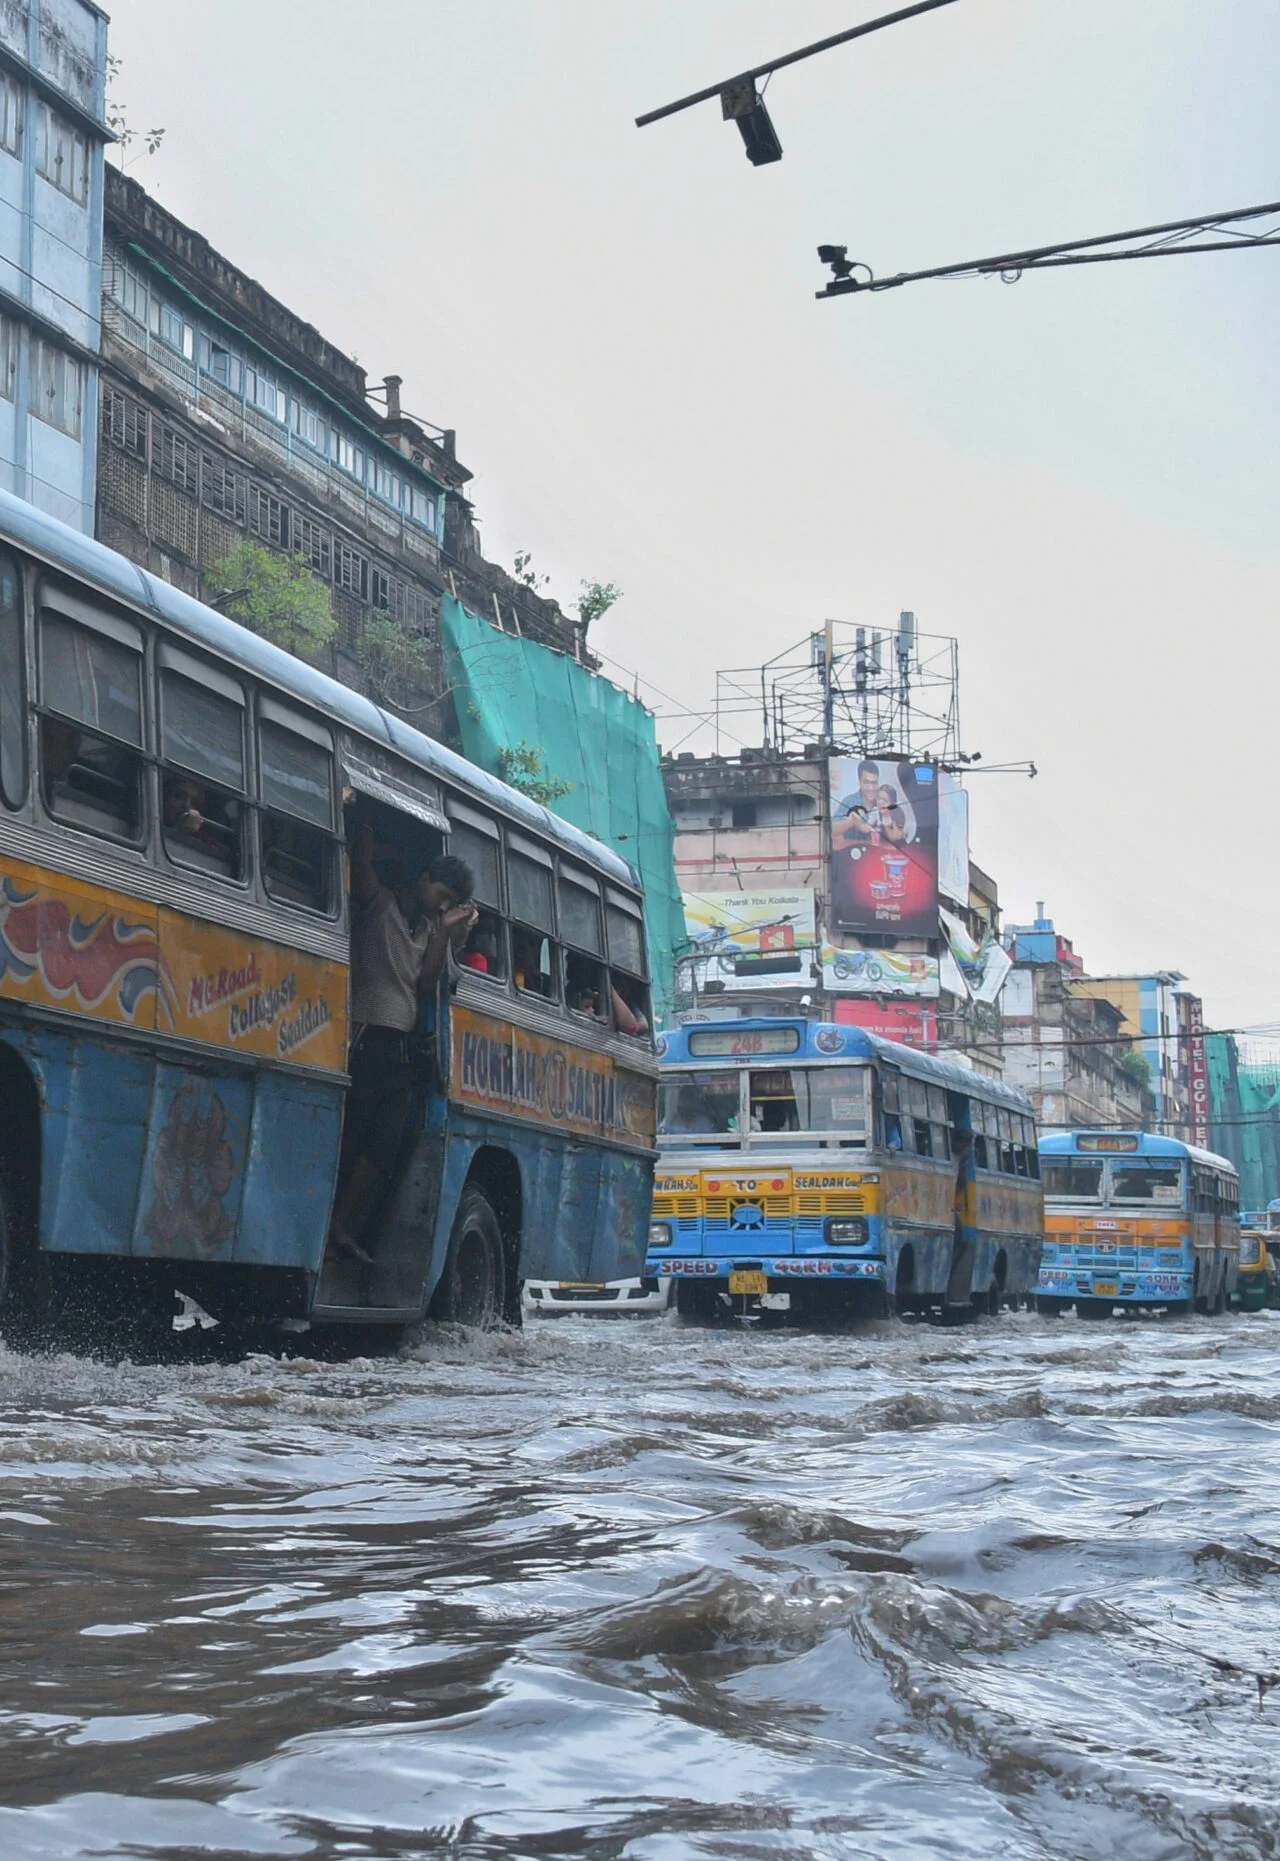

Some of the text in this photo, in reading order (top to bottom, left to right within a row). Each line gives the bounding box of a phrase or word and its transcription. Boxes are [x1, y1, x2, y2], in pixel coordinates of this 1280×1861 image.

[724, 897, 749, 907] Thank
[1190, 1013, 1203, 1074] HOTEL
[735, 1178, 757, 1192] TO
[794, 1176, 844, 1189] SEALDAH
[661, 1261, 718, 1274] SPEED
